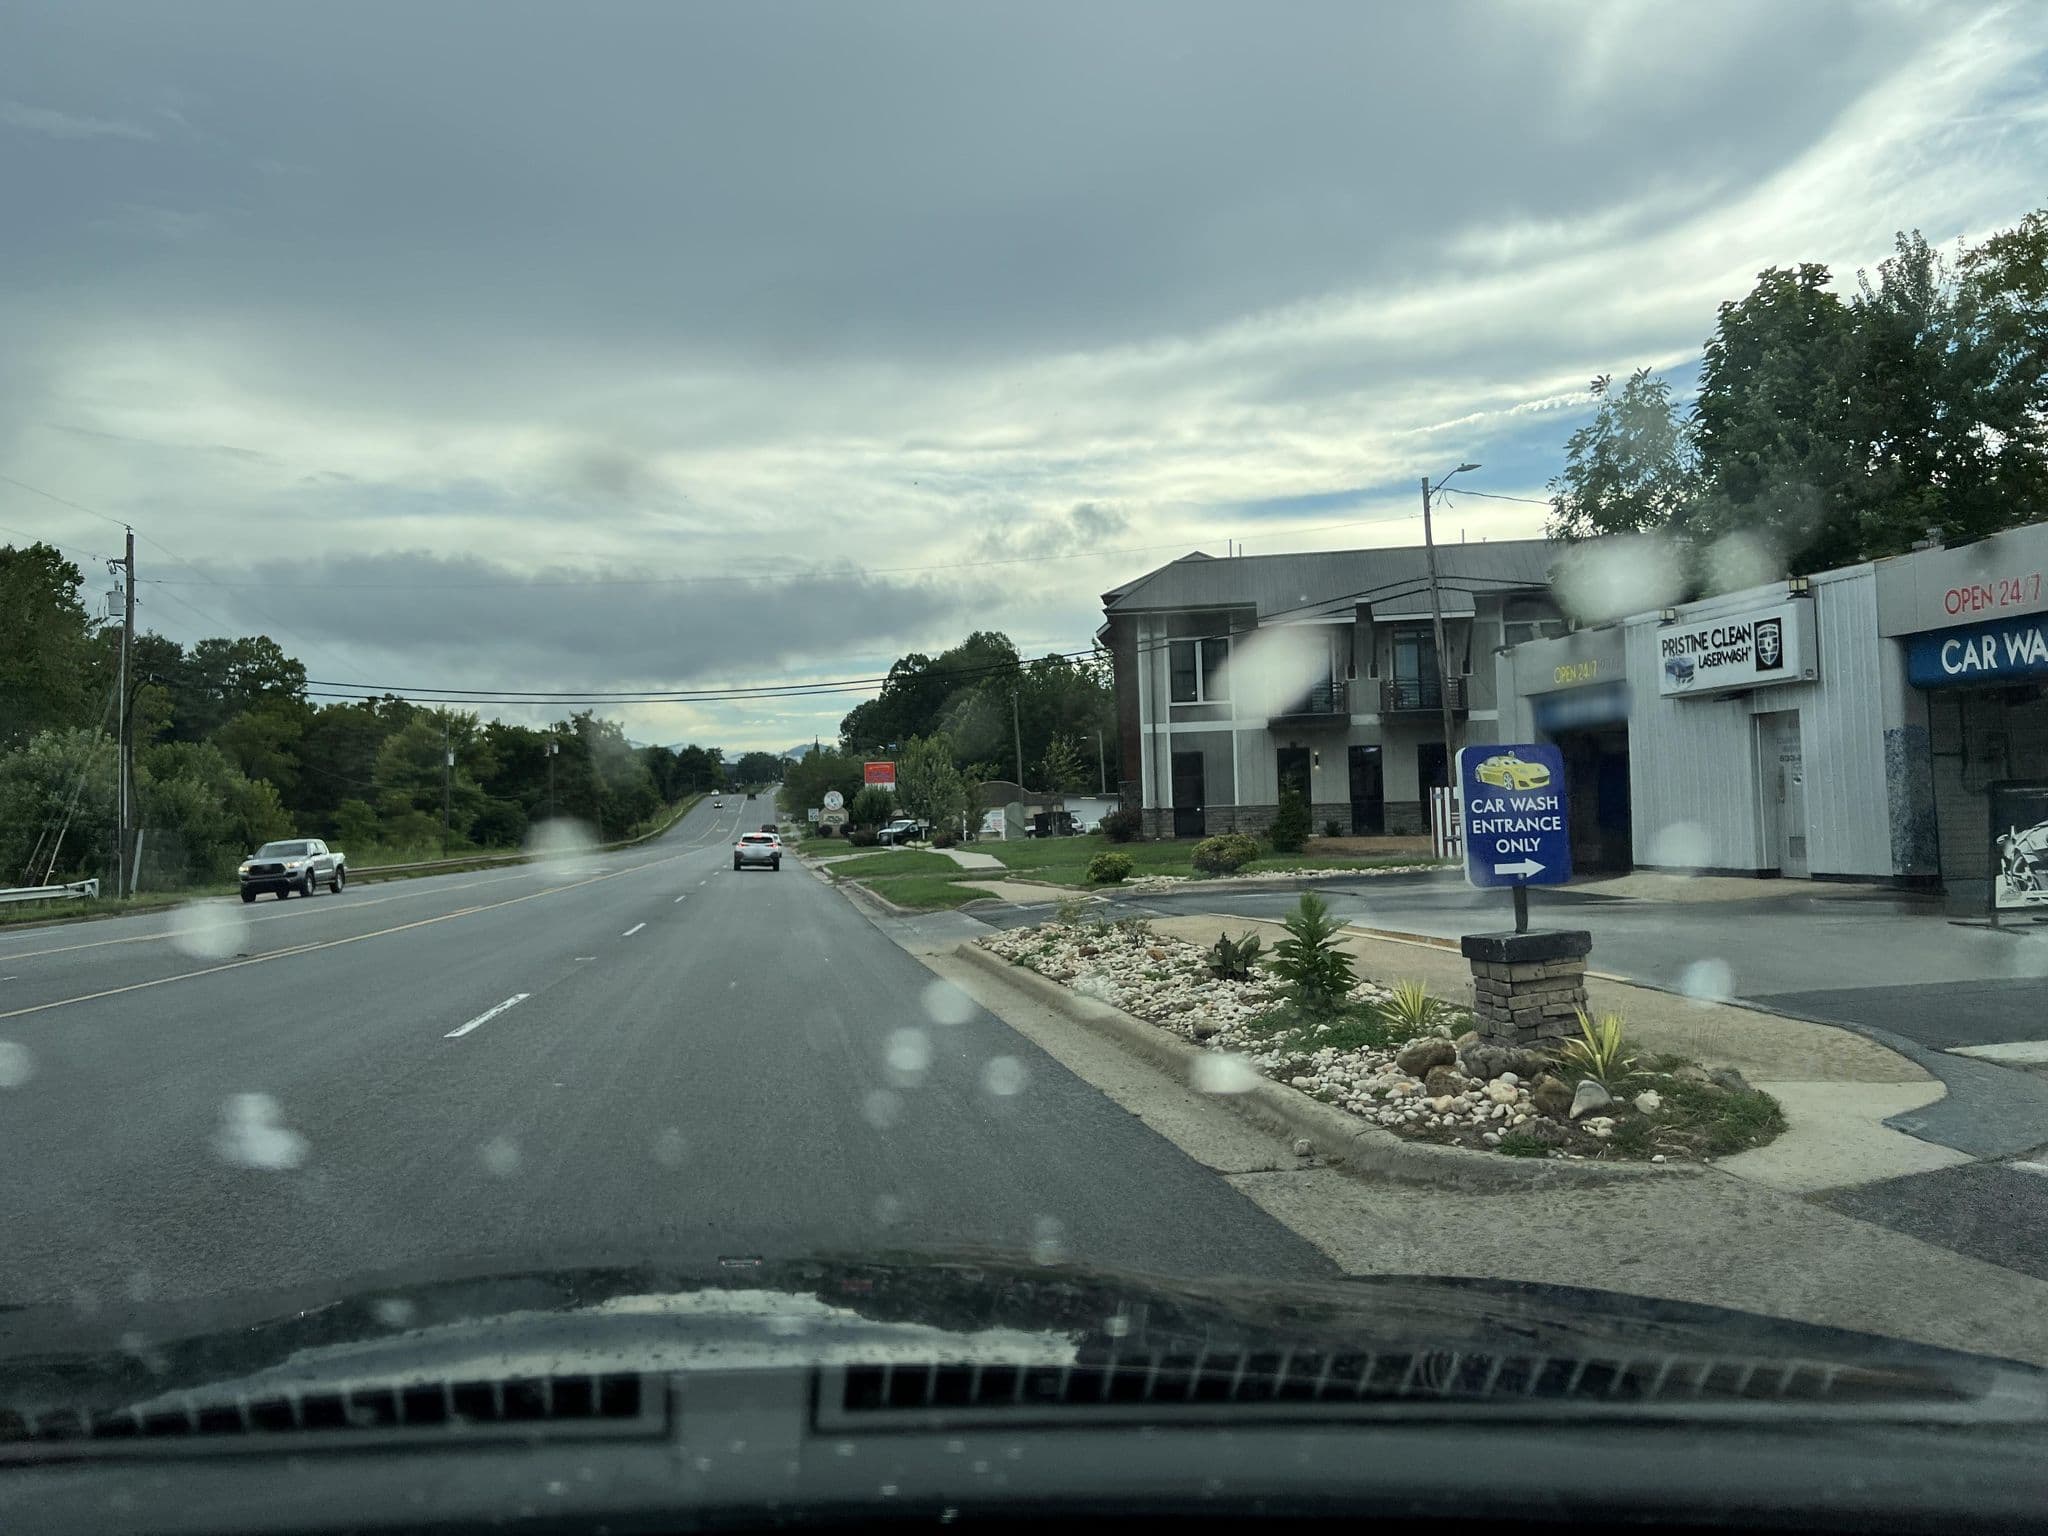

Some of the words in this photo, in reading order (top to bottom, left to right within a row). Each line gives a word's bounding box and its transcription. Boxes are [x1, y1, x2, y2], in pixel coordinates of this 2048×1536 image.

[1945, 584, 1993, 614] OPEN
[1662, 631, 1708, 657] PRISTINE
[1711, 623, 1752, 649] CLEAN
[1941, 635, 1998, 674] CAR
[1554, 664, 1577, 684] OPEN
[1471, 799, 1506, 814] CAR
[1510, 796, 1559, 812] WASH
[1472, 816, 1562, 834] ENTRANCE
[1495, 837, 1541, 854] ONLY
